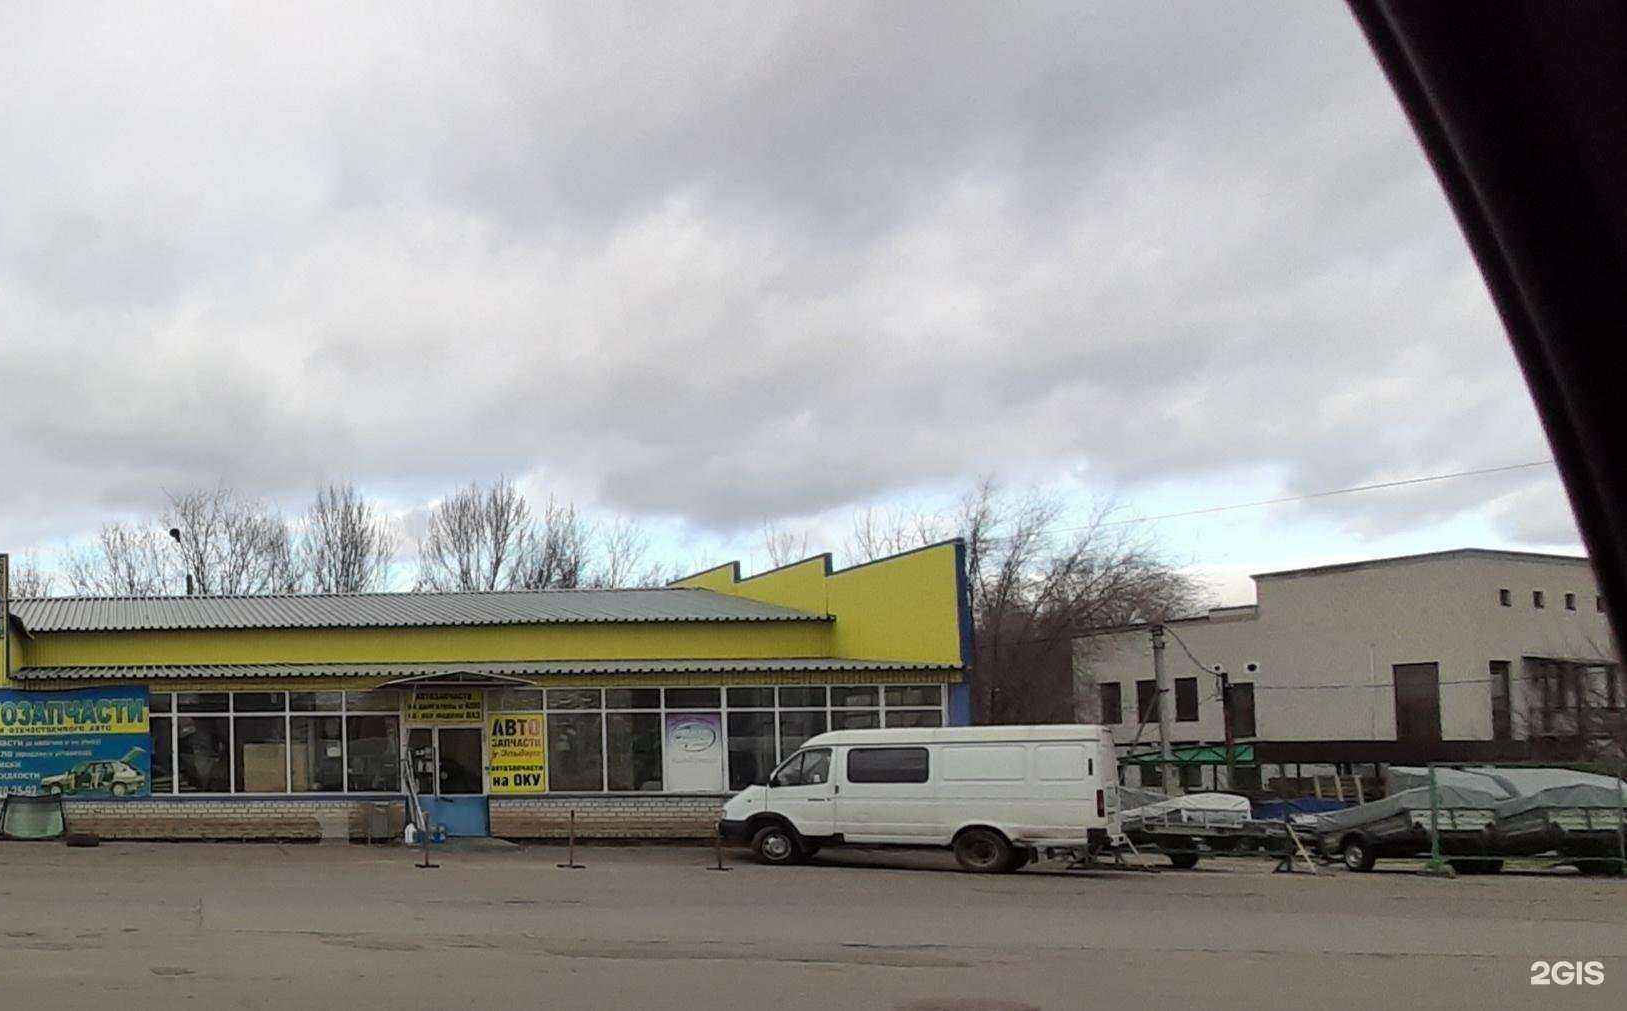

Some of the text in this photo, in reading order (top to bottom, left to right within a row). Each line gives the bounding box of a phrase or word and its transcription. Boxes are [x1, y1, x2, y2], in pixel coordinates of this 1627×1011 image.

[492, 718, 542, 736] АВТО
[491, 738, 542, 748] ЗАПЧАСТИ
[492, 773, 541, 787] на ОКУ
